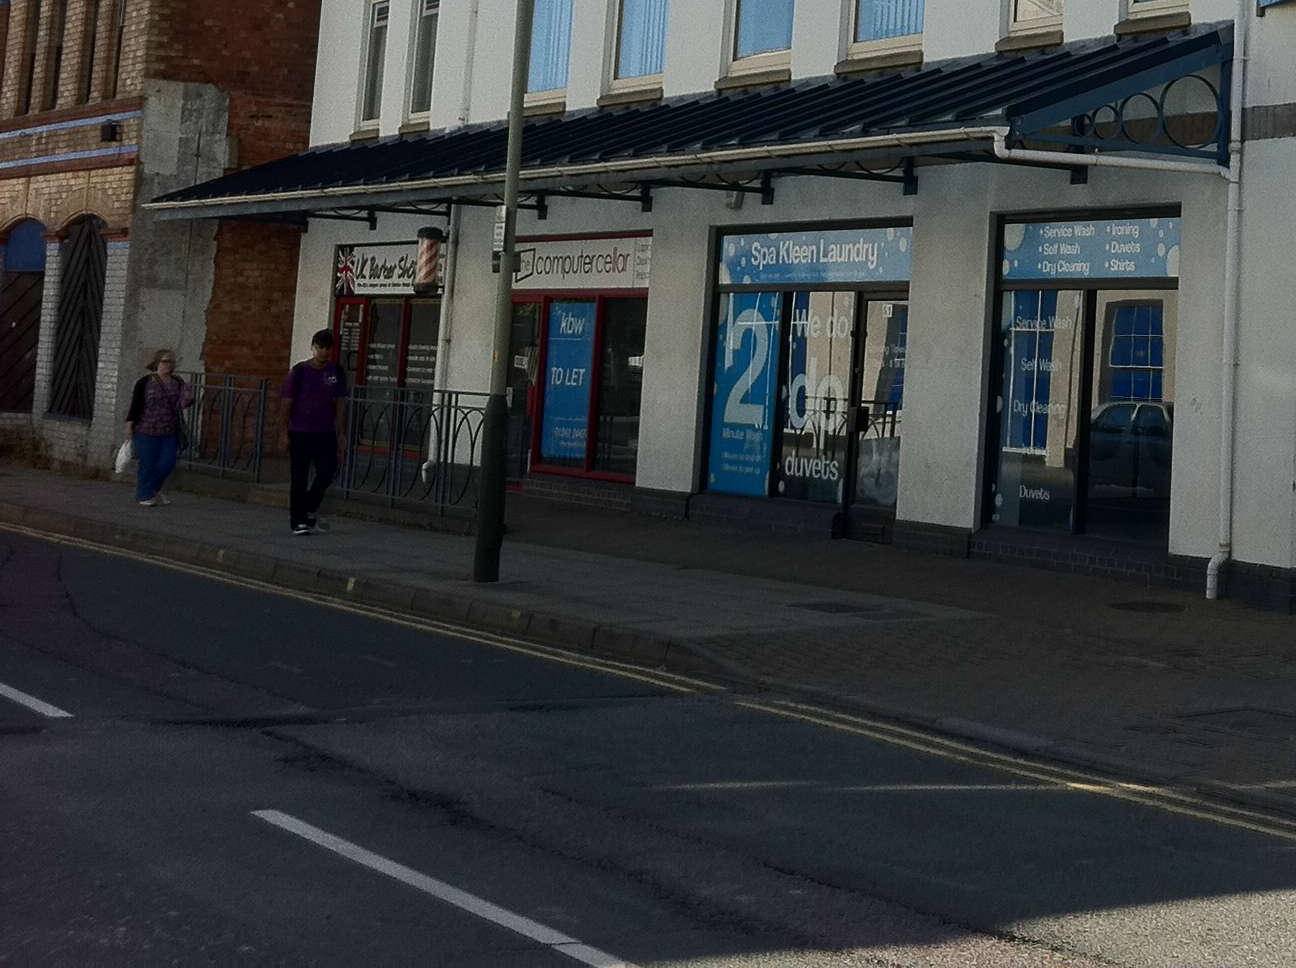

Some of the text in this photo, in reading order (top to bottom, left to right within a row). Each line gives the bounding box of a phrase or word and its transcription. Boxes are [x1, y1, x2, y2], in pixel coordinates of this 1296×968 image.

[1074, 225, 1095, 237] Wash
[751, 238, 878, 270] Spa Kleen Laundry
[1060, 242, 1080, 254] Wash
[398, 253, 417, 280] Sho
[536, 247, 630, 279] computercellar
[560, 312, 585, 335] kbw
[551, 367, 586, 386] TO LET
[724, 308, 769, 425] 2
[785, 450, 839, 481] duvets
